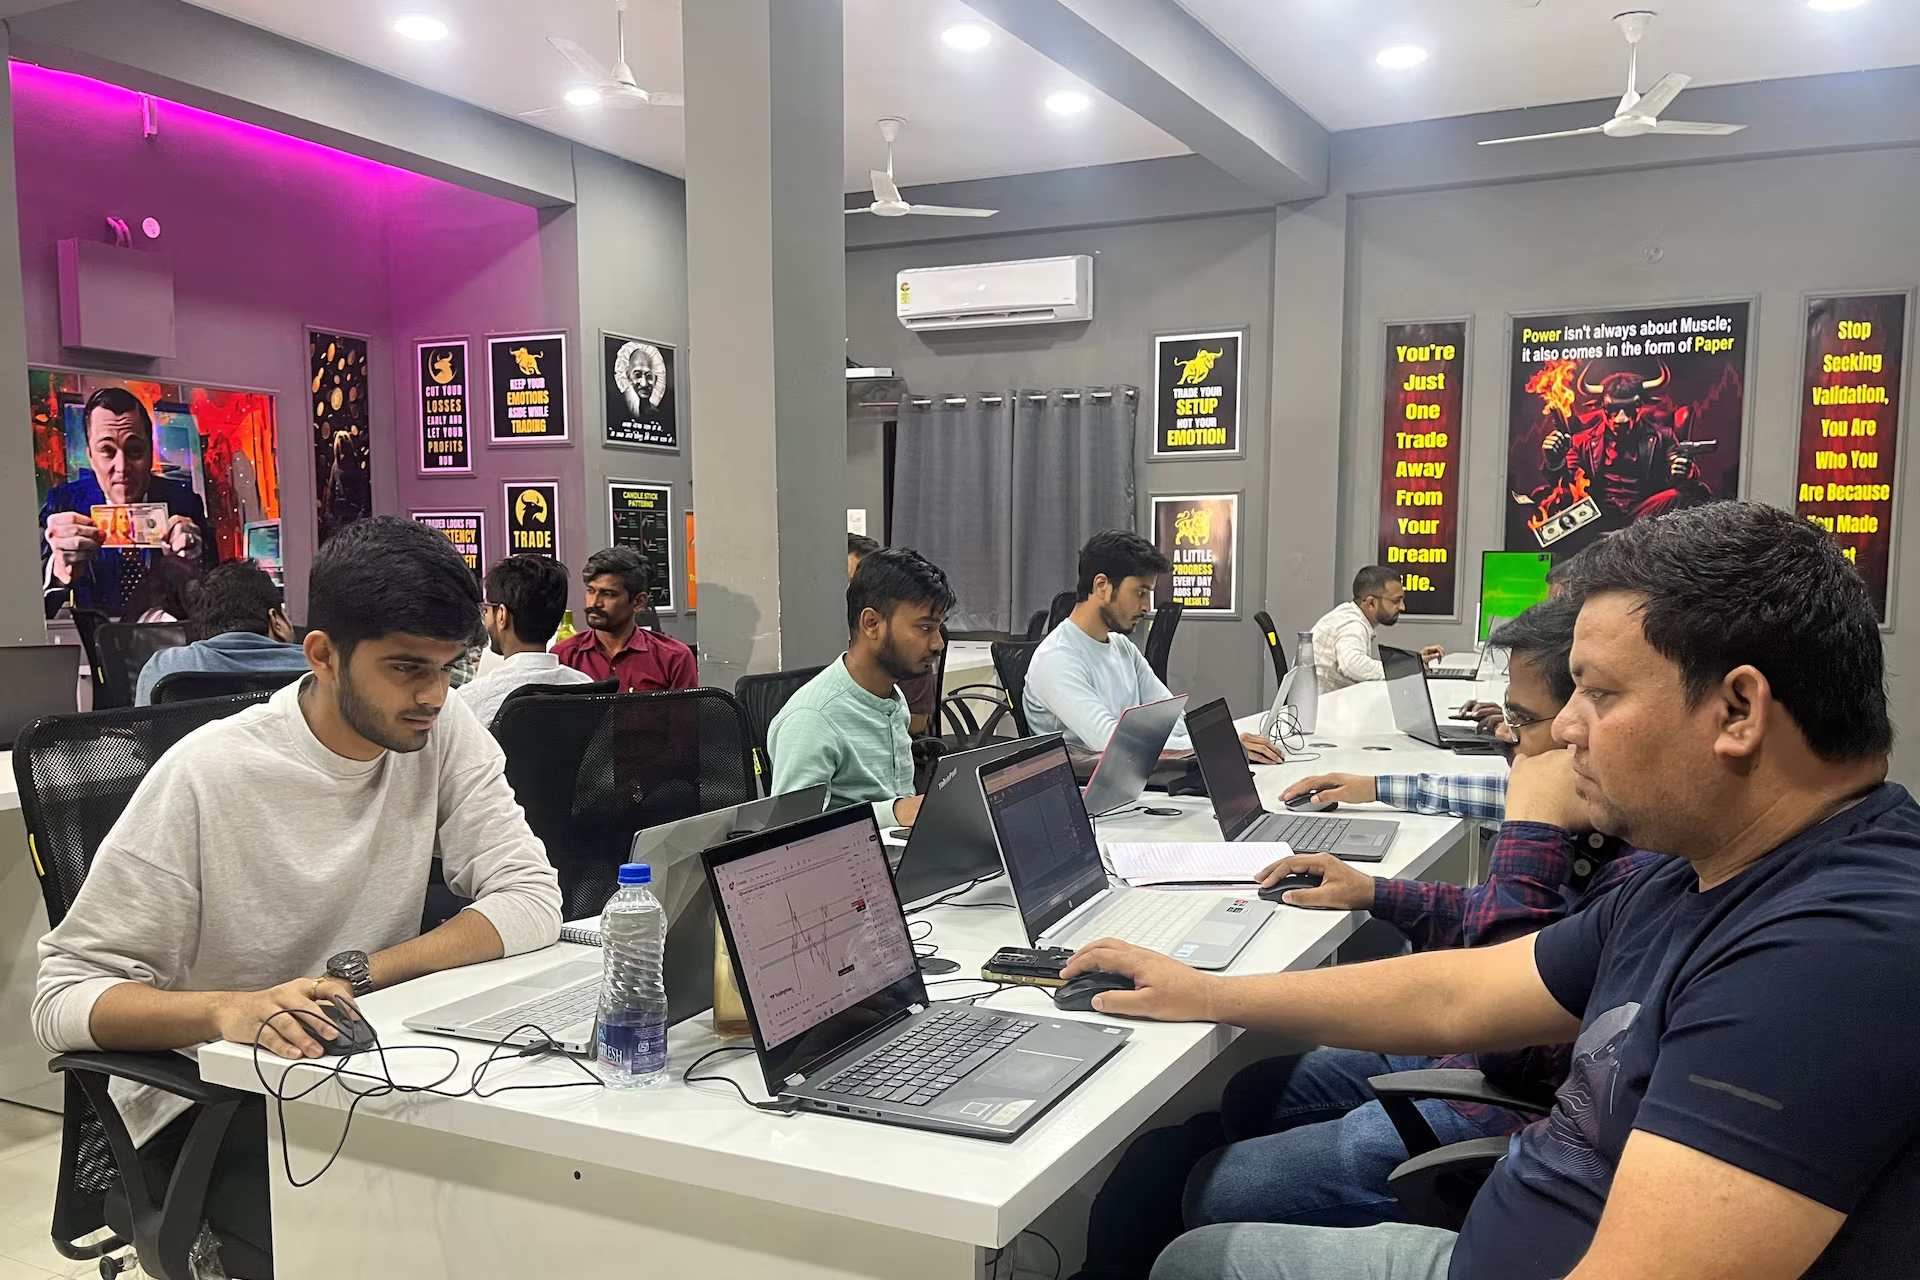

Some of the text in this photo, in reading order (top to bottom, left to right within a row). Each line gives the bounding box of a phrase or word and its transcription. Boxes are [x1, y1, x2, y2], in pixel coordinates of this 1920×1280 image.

[1523, 315, 1732, 344] Power isn't always about Muscle;
[1838, 320, 1872, 341] Stop
[1396, 344, 1455, 363] You're
[1522, 336, 1735, 362] it also comes in the form of Paper
[1823, 351, 1883, 374] Seeking
[1403, 372, 1445, 391] Just
[425, 385, 462, 397] CUT YOUR
[507, 390, 549, 406] EMOTIONS
[1173, 386, 1222, 399] TRADE YOUR
[1812, 384, 1889, 406] Validation,
[426, 399, 462, 413] LOSSES
[508, 406, 549, 419] ASIDE WHILE
[1176, 398, 1219, 416] SETUP
[1405, 403, 1441, 420] One
[427, 415, 462, 425] EARLY AND
[511, 419, 547, 433] TRADING
[1176, 417, 1217, 429] NOT YOUR
[1821, 418, 1877, 438] You Are
[427, 426, 463, 438] LET YOUR
[1167, 428, 1226, 446] EMOTION
[1396, 431, 1448, 449] Trade
[427, 440, 464, 453] PROFITS
[1815, 450, 1878, 470] Who You
[1395, 461, 1446, 479] Away
[1396, 489, 1443, 506] From
[1799, 482, 1890, 502] Are Because
[465, 519, 477, 529] FOR
[1397, 517, 1440, 535] Your
[1837, 514, 1878, 534] Made
[513, 530, 552, 548] TRADE
[1173, 549, 1212, 563] A LITTLE
[1387, 546, 1448, 563] Dream
[1172, 563, 1213, 576] PROGRESS
[1173, 576, 1212, 587] EVERY DAY
[1173, 587, 1211, 597] ADDS UP TO
[1184, 597, 1210, 607] RESULTS
